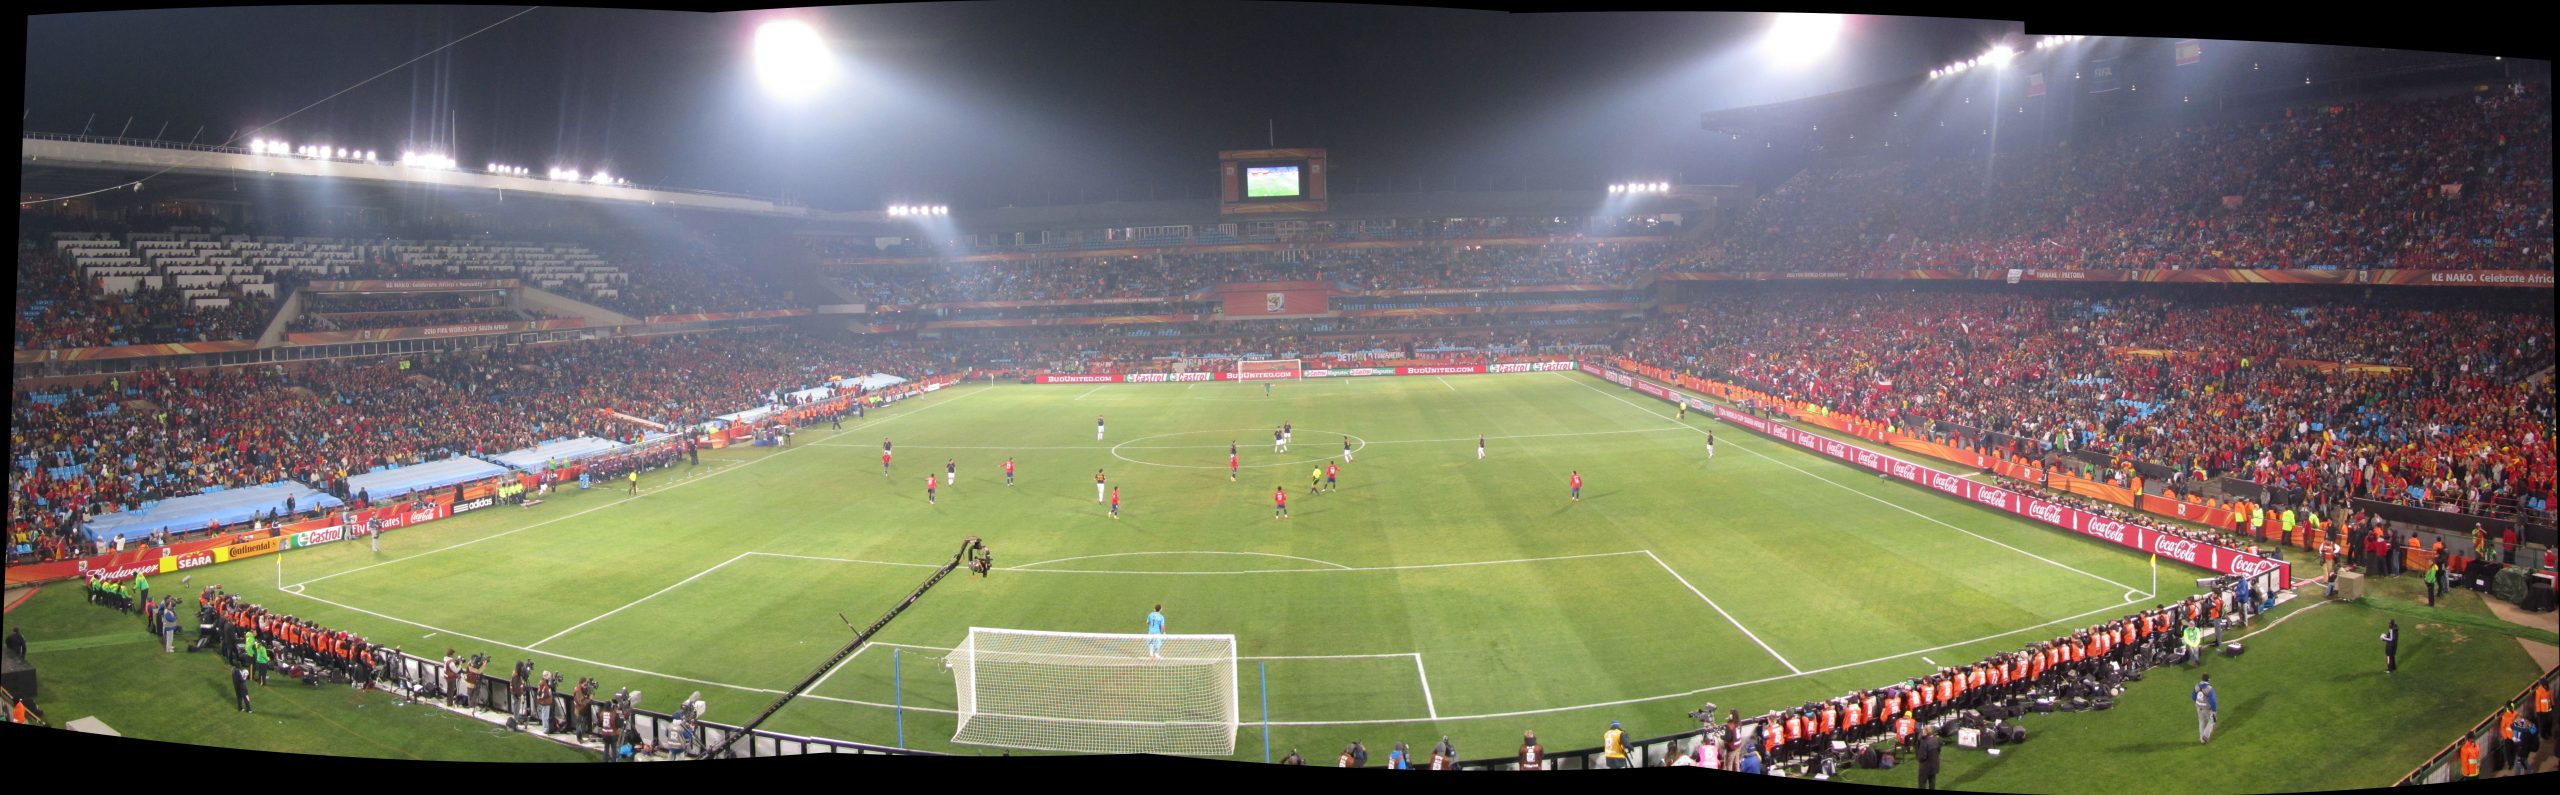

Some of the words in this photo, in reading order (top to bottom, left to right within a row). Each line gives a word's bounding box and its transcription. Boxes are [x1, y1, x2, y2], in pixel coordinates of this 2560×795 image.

[2432, 273, 2443, 282] KE
[2480, 273, 2525, 283] Celebrate
[468, 498, 493, 510] adidas
[309, 529, 341, 544] Castrol
[352, 523, 365, 536] Fly
[229, 541, 271, 558] Continental
[178, 555, 212, 569] SEARA
[86, 564, 159, 581] Budweiser
